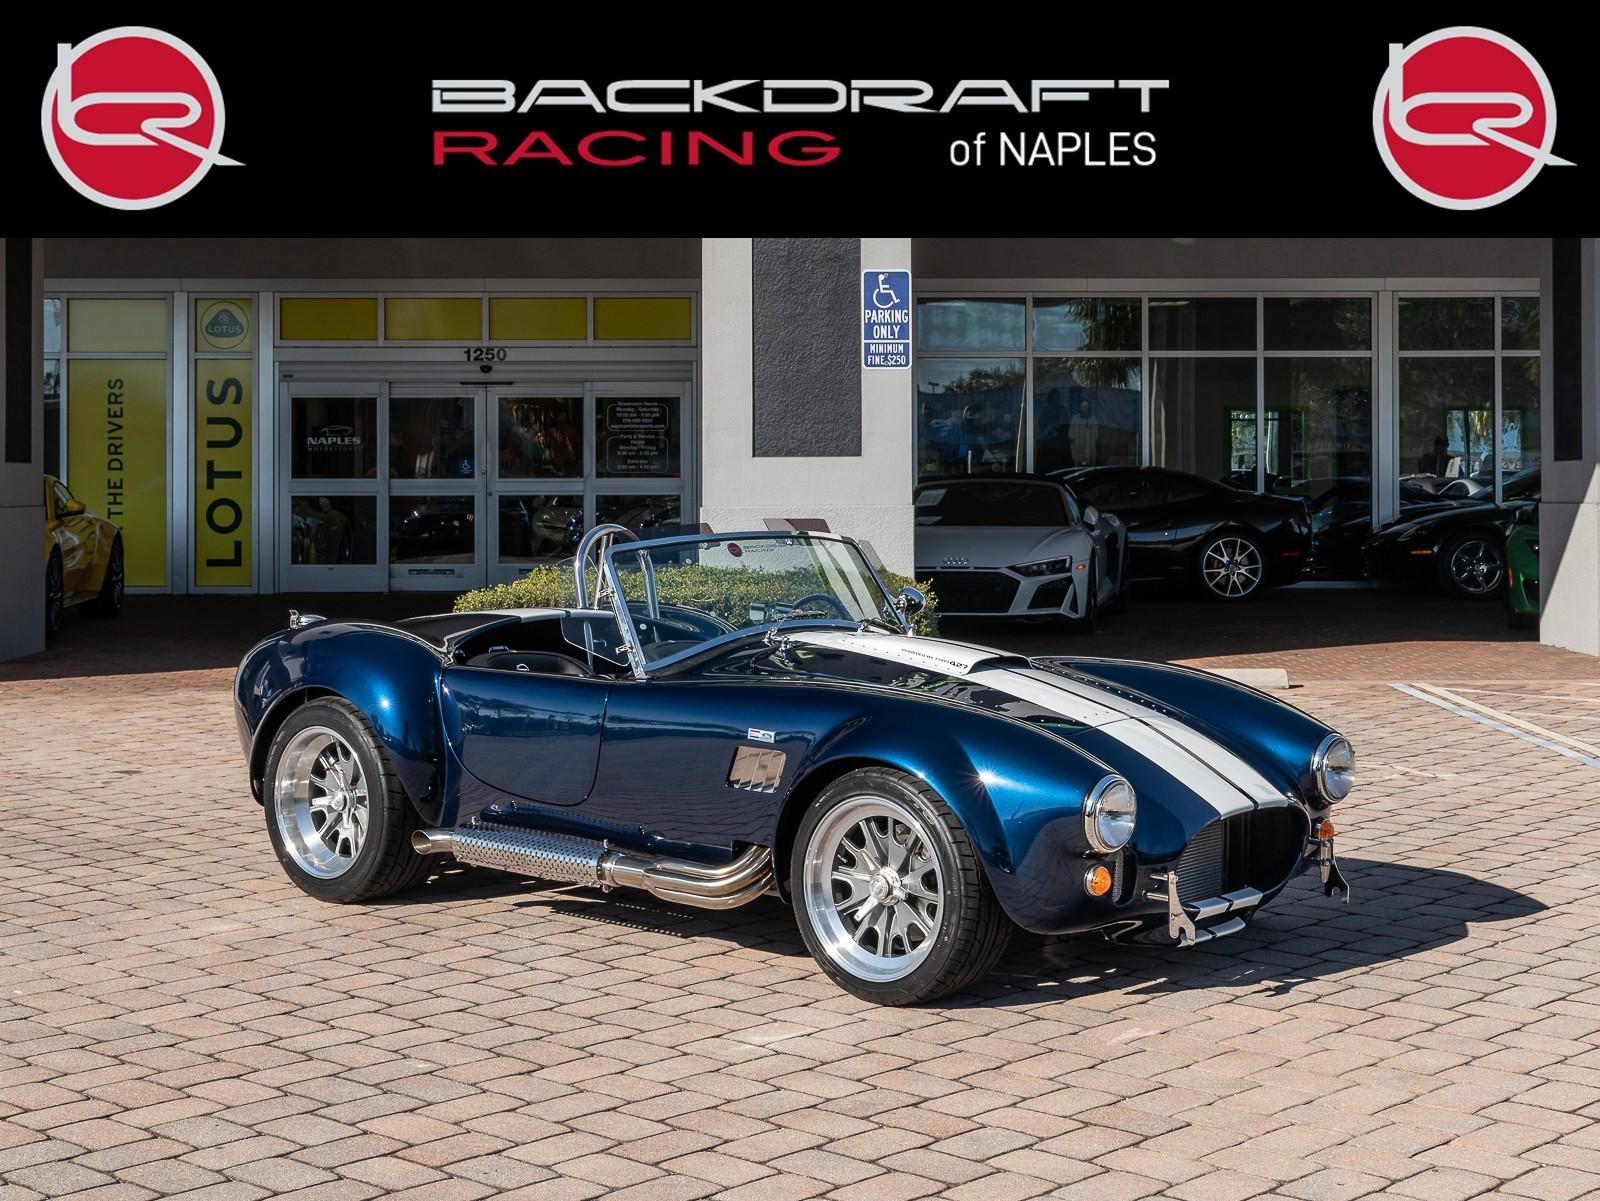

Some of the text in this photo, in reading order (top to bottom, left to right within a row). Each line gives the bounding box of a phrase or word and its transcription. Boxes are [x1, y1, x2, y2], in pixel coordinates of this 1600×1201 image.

[864, 309, 909, 324] PARKING
[208, 325, 242, 334] LOTUS
[873, 325, 900, 339] ONLY
[464, 348, 507, 361] 1250
[870, 343, 904, 354] MINIMUM
[868, 354, 906, 366] FINE $250
[107, 378, 124, 471] DRIVERS
[206, 377, 243, 567] LOTUS
[107, 478, 124, 520] THE
[950, 660, 968, 669] 427
